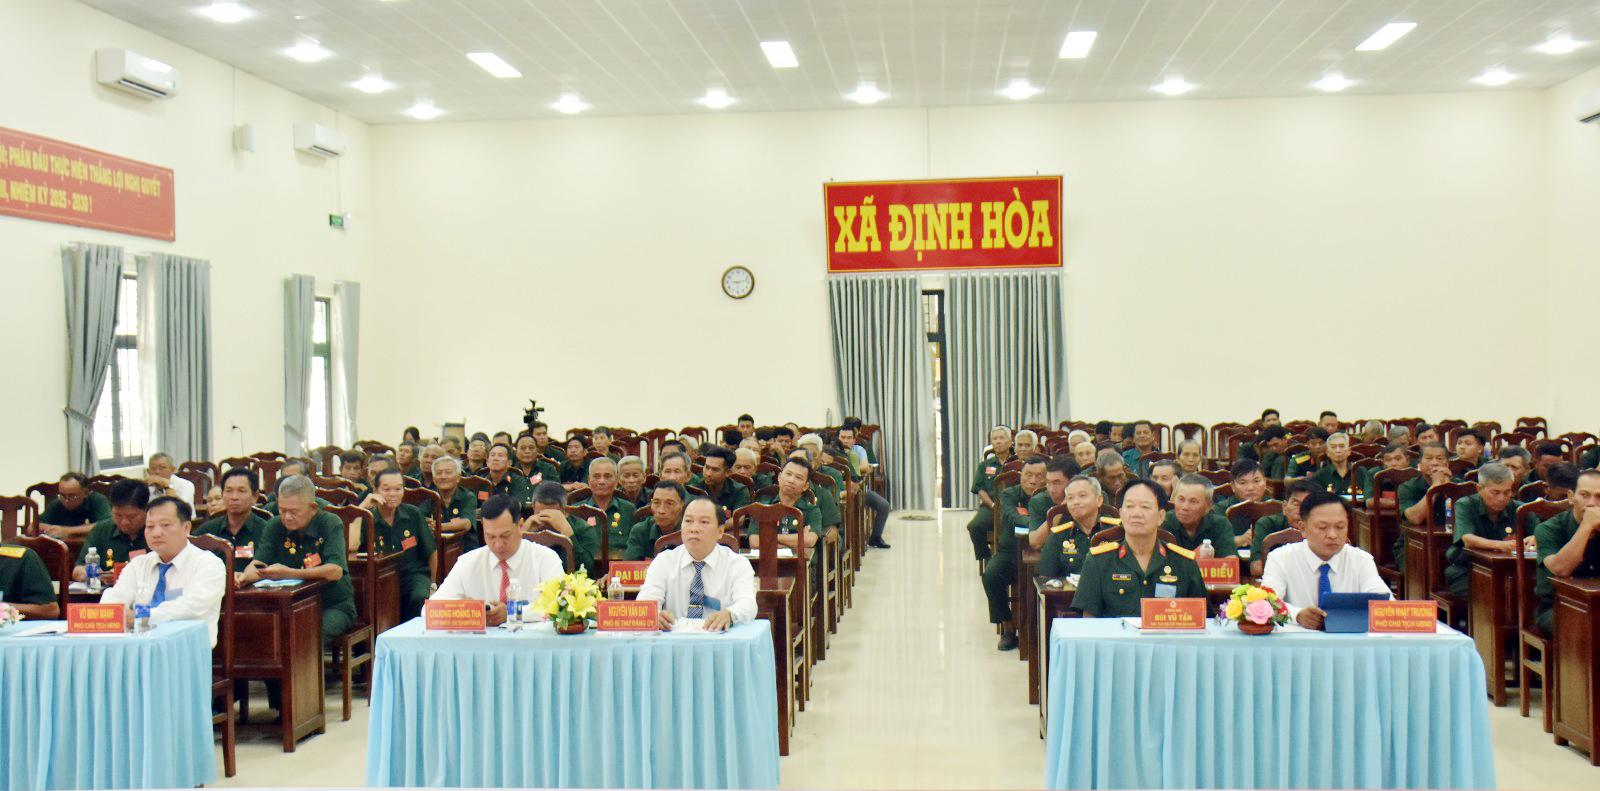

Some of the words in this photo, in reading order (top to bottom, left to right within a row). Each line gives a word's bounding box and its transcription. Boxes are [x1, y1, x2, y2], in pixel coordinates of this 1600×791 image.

[10, 179, 35, 208] NHIỆM
[37, 181, 48, 205] KỲ
[50, 188, 66, 208] 2025
[833, 195, 882, 253] XÃ
[888, 202, 973, 262] ĐỊNH
[981, 186, 1054, 249] HÒA
[1210, 562, 1234, 578] BIỂU
